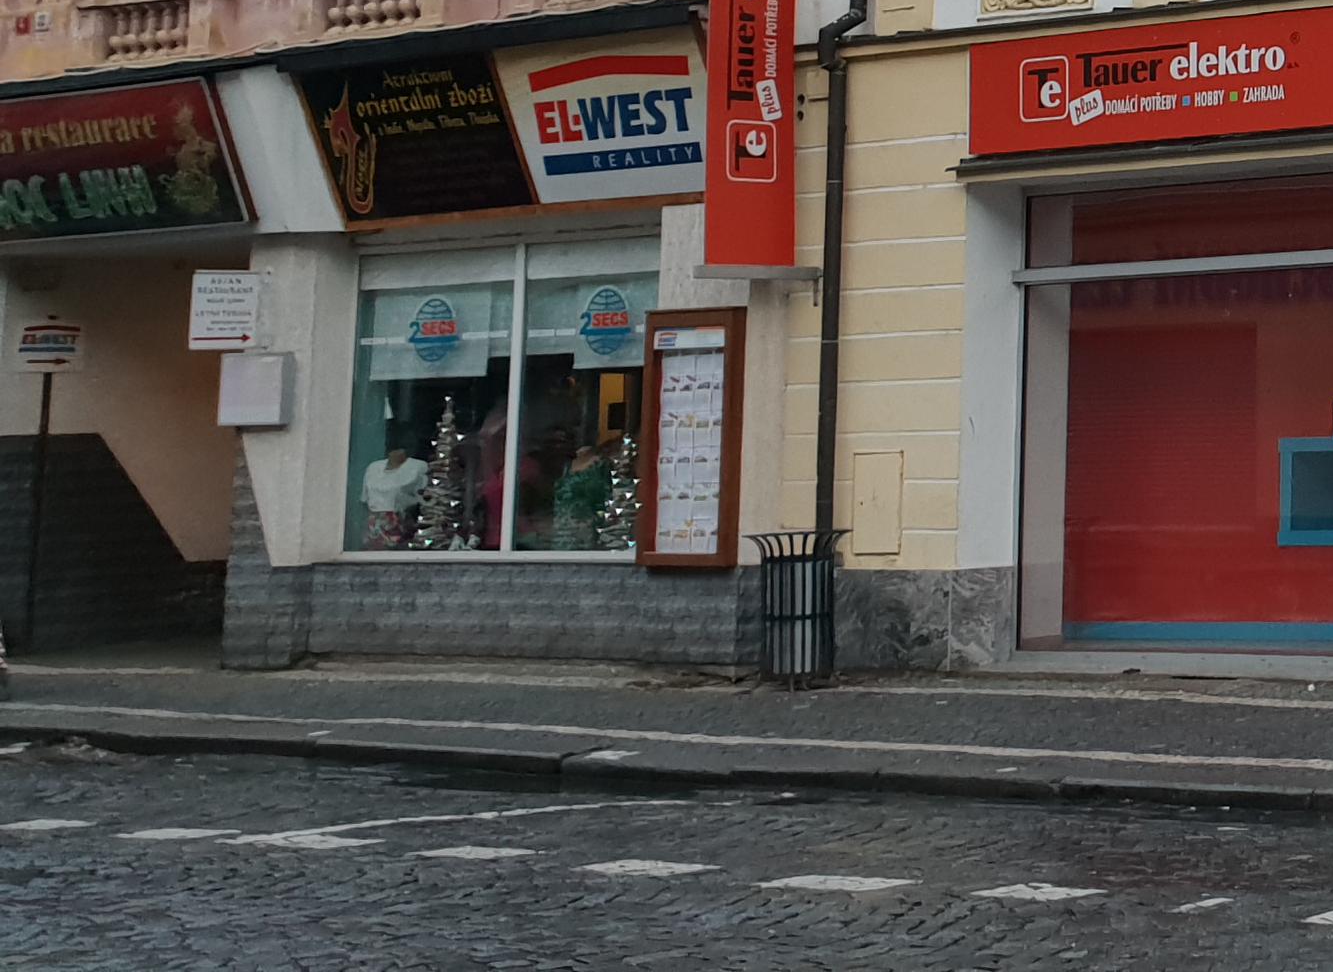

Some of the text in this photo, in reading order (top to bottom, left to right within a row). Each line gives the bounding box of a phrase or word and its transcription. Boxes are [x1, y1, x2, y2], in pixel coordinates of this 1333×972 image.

[728, 3, 755, 110] Tauer
[764, 37, 777, 78] DOMÁCÍ
[1075, 46, 1167, 89] Tauer
[1170, 42, 1286, 81] elektro
[765, 84, 781, 116] plus
[1074, 95, 1099, 123] plus
[1105, 84, 1286, 116] DOMÁCÍ POTŘEBY HOBBY ZAHRADA
[21, 114, 158, 152] restaurace
[592, 146, 694, 169] REALITY
